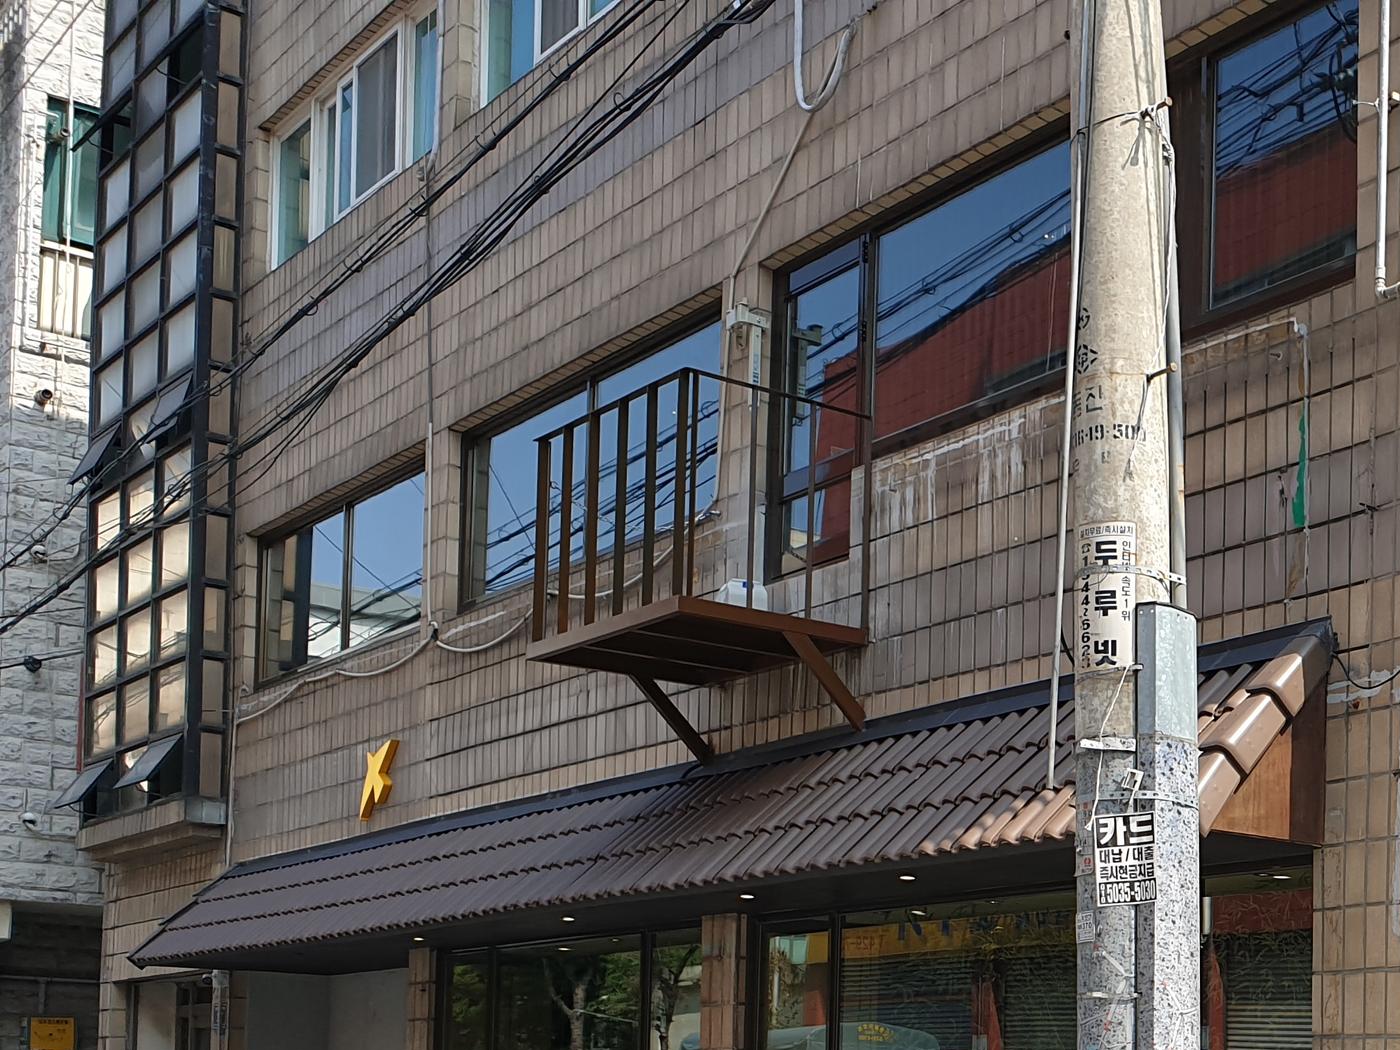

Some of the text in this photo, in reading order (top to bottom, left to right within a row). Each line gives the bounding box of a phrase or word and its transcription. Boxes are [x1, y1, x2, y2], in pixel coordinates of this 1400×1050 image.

[1094, 541, 1118, 666] 두루넷
[1098, 815, 1154, 846] 카드
[1100, 863, 1155, 881] 즉시현금지급
[1106, 880, 1156, 904] 5035-5030
